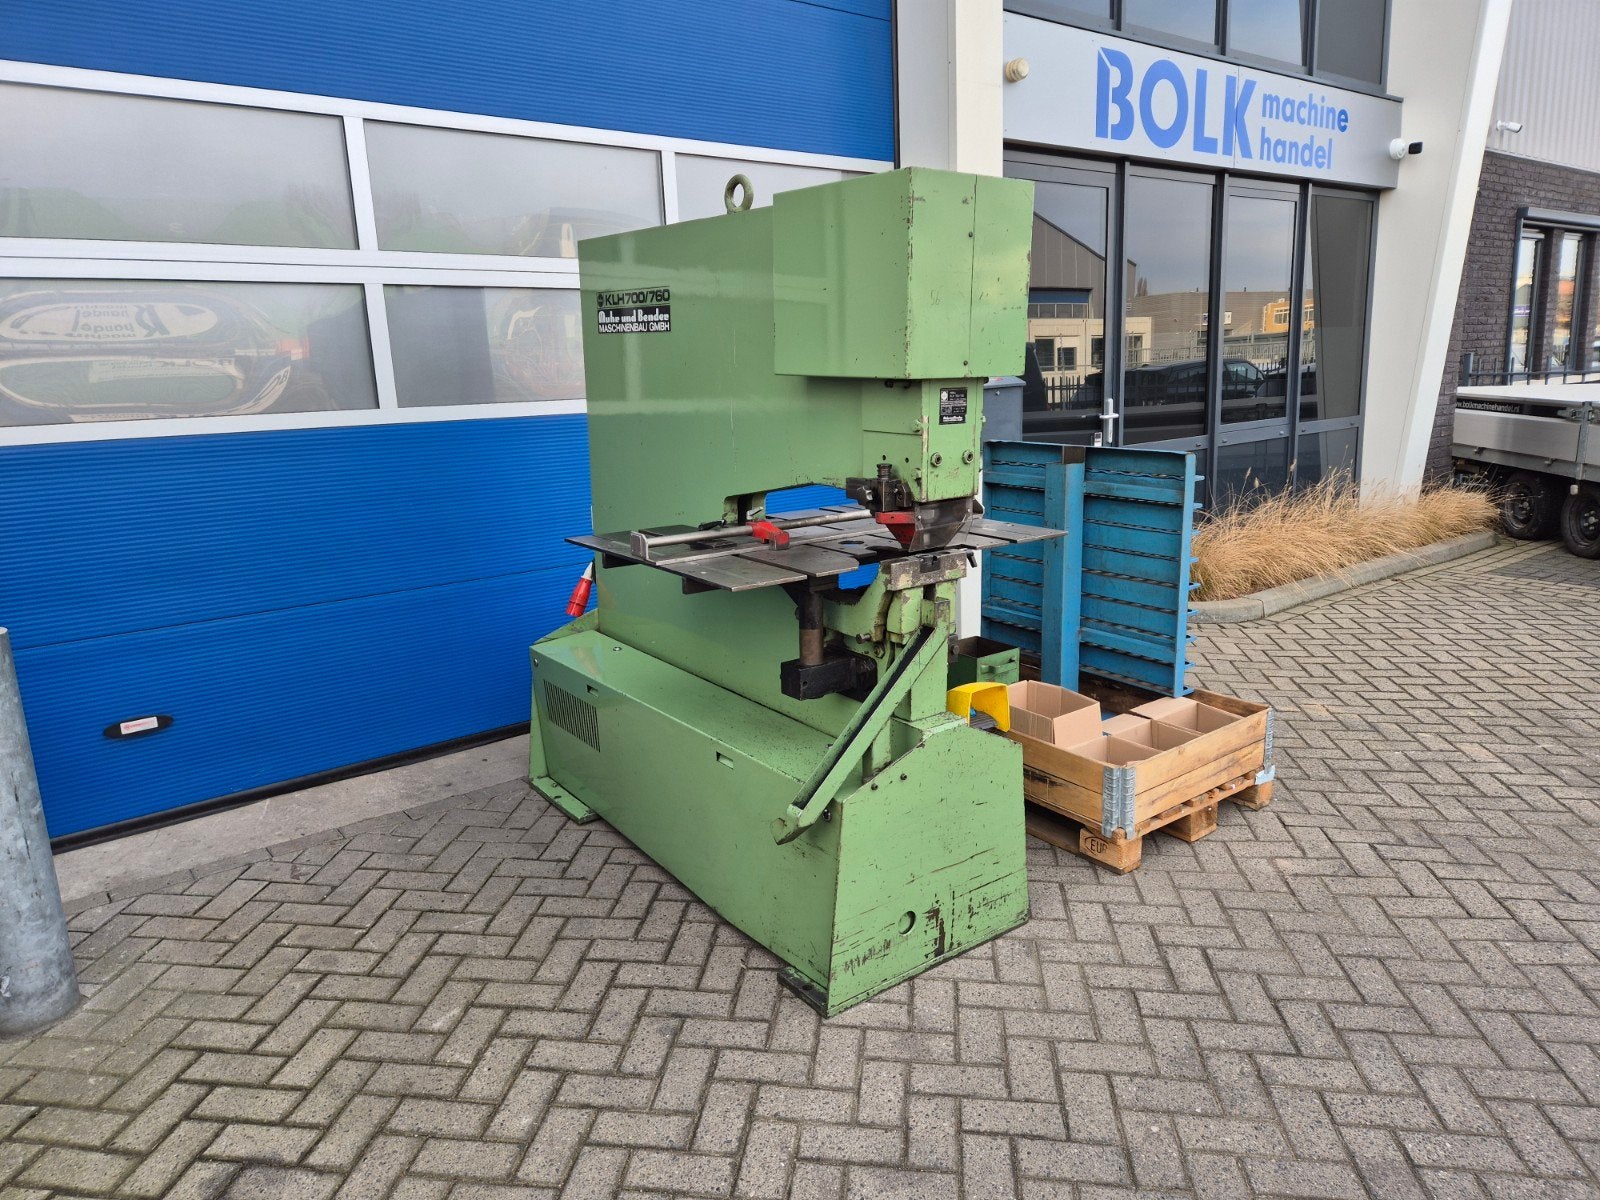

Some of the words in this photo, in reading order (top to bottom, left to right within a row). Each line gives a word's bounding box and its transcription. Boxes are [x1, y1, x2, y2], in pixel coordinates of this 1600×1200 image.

[1095, 46, 1257, 160] BOLK
[1261, 92, 1349, 133] machine
[1259, 127, 1333, 170] handel
[598, 323, 648, 333] MASCHINENBAU
[649, 321, 670, 331] GMBH
[621, 309, 637, 323] und
[637, 308, 669, 322] Bender
